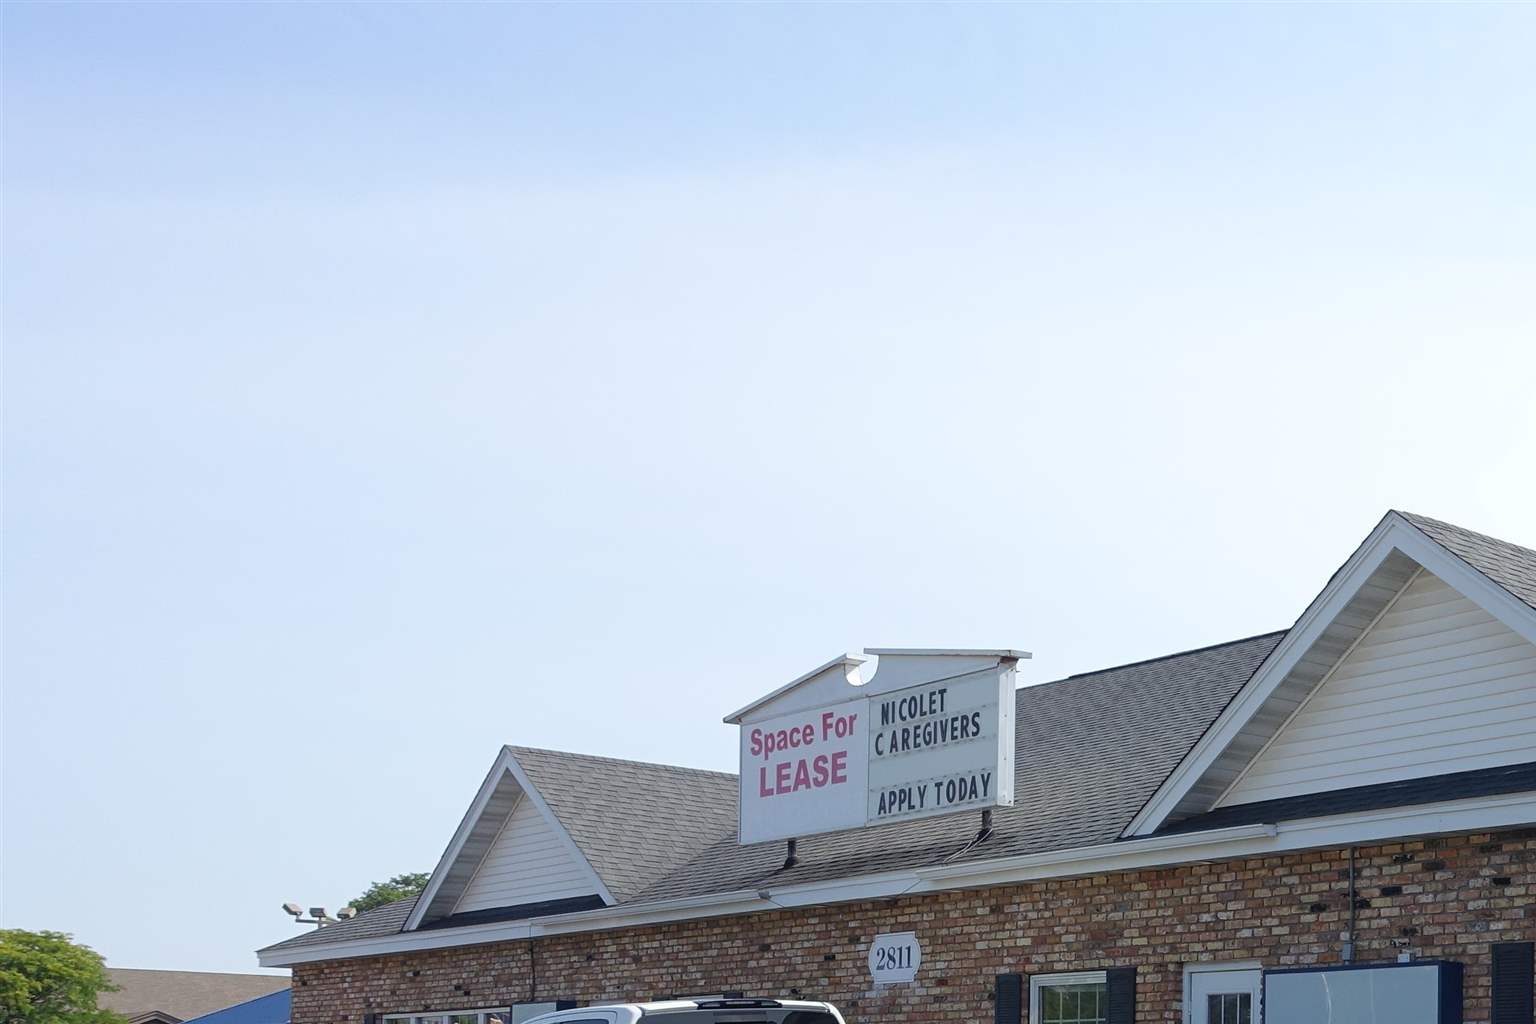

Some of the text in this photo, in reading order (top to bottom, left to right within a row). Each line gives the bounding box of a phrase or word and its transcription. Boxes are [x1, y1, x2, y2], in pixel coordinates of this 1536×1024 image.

[881, 688, 948, 726] NICOLET
[750, 712, 858, 761] Space For
[760, 750, 848, 798] LEASE
[878, 772, 991, 815] APPLY TODAY
[876, 945, 913, 970] 2811
